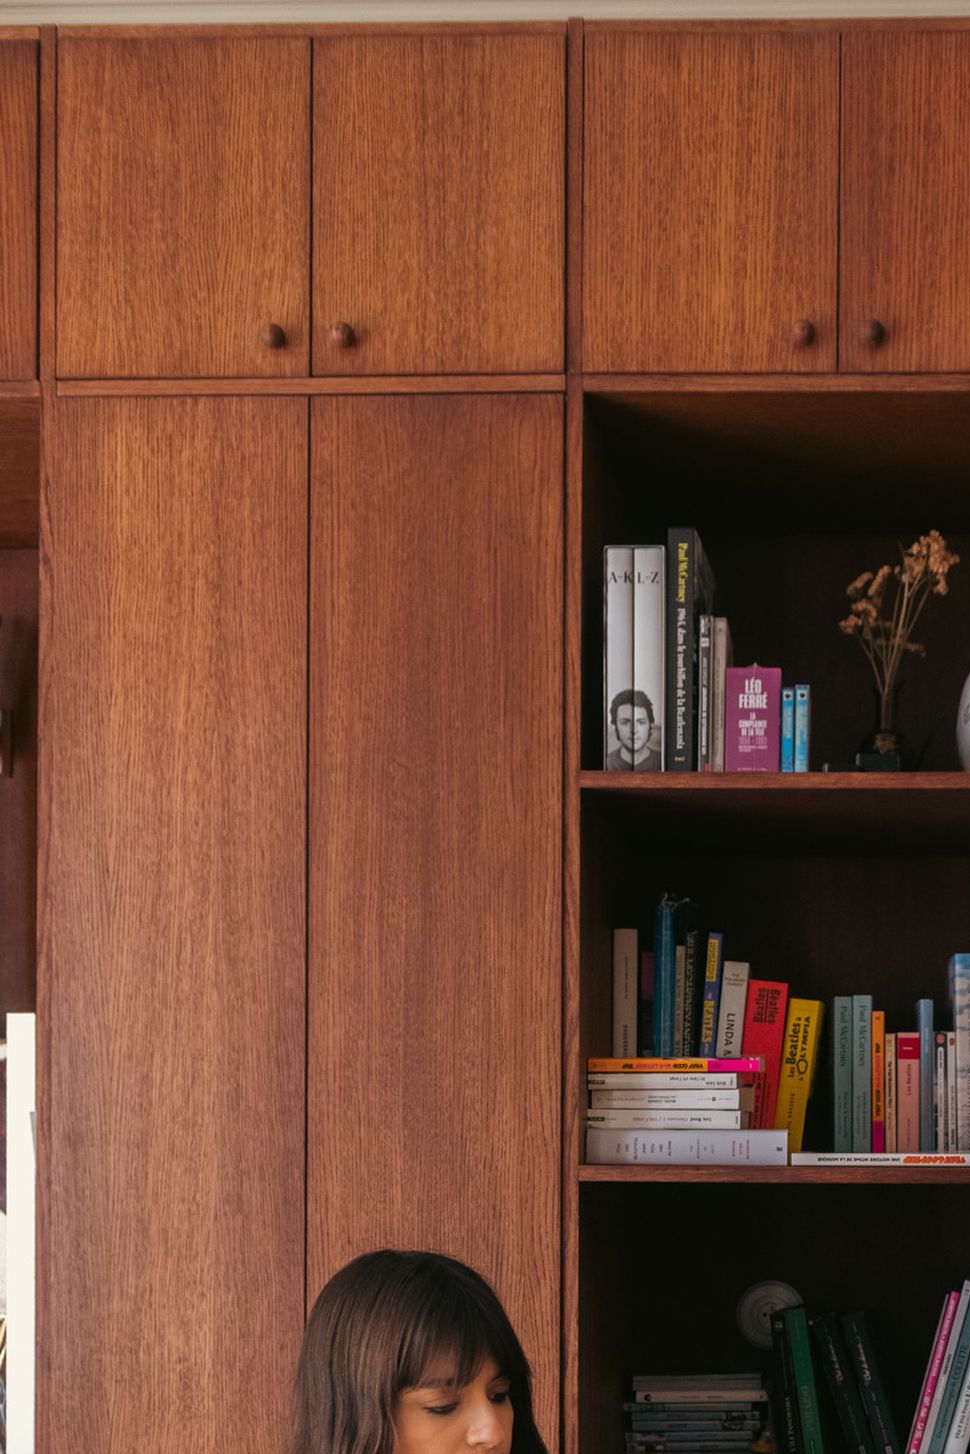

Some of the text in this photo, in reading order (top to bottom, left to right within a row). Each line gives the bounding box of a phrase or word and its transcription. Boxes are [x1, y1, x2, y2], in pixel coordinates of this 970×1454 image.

[608, 571, 633, 584] A-K
[637, 571, 660, 584] L-Z
[676, 542, 689, 603] Paul McCartney
[739, 692, 768, 709] FERRÉ
[745, 677, 762, 694] LÉO
[724, 1012, 736, 1046] LINDA
[786, 1023, 800, 1066] Beatles
[838, 1025, 848, 1067] McCartney
[857, 1024, 867, 1067] McCartney
